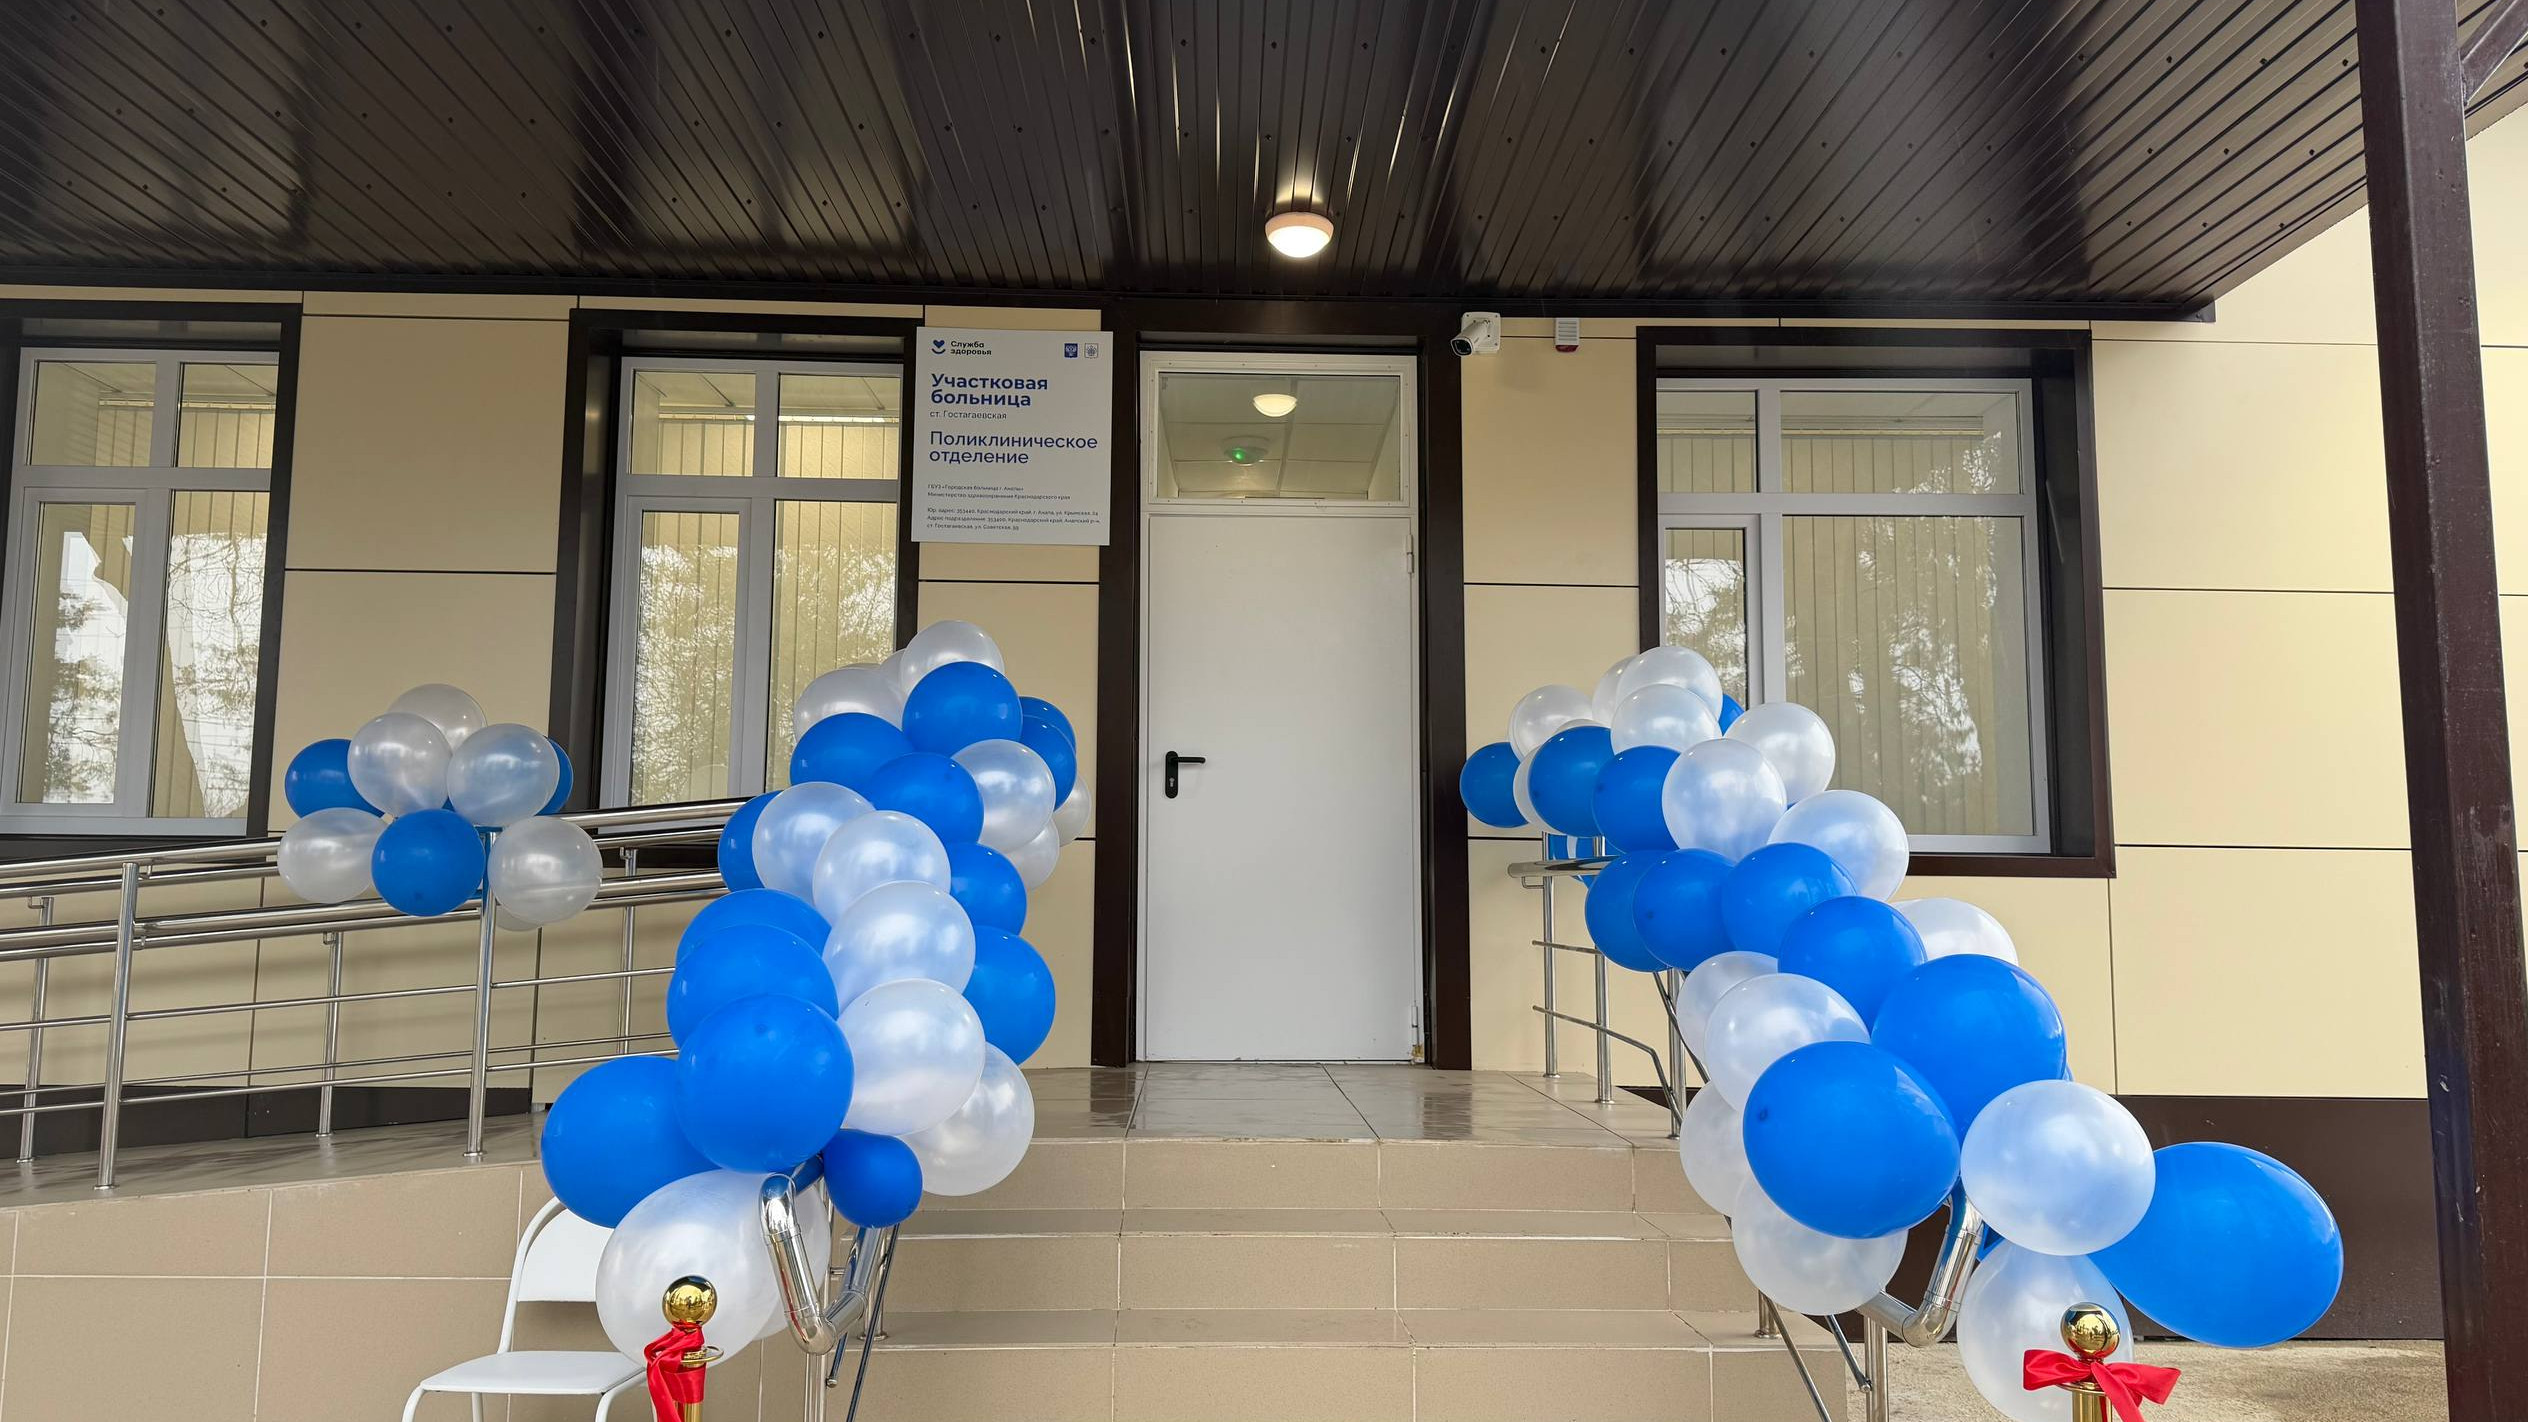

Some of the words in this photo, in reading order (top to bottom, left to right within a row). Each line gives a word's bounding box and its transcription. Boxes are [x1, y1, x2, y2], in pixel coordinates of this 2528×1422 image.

[951, 341, 984, 349] Служба
[931, 373, 1048, 390] Участковая
[931, 389, 1031, 408] больница
[943, 410, 1007, 420] Гостагаевская
[930, 431, 1098, 448] Поликлиническое
[929, 450, 1029, 464] отделение
